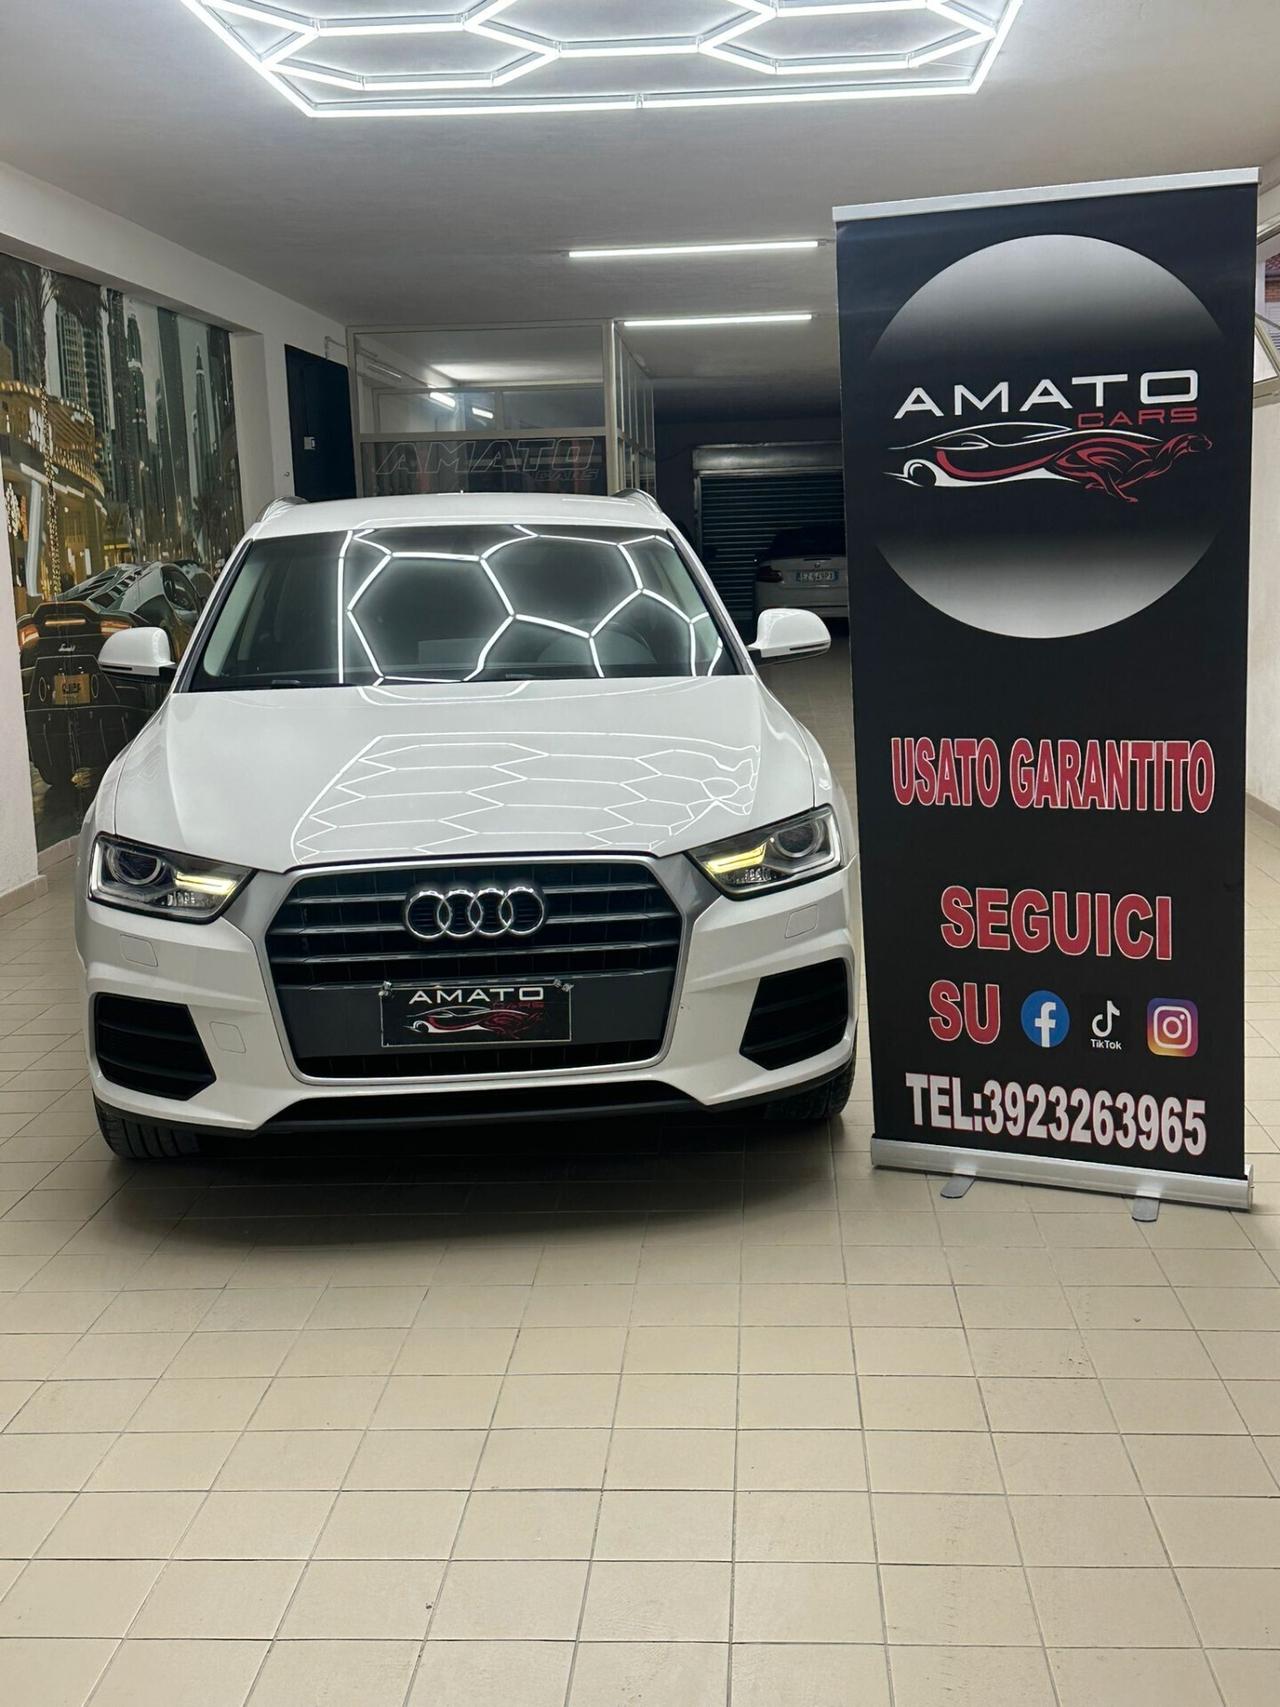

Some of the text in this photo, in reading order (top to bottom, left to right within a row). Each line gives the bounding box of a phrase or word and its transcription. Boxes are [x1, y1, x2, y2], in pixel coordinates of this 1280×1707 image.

[894, 369, 1199, 420] AMATO
[1077, 407, 1199, 429] CARS
[376, 438, 595, 475] AMATO
[891, 737, 1215, 813] USATO GARANTITO
[940, 886, 1172, 960] SEGUICI
[409, 987, 544, 1004] AMATO
[929, 980, 1000, 1044] SU
[1090, 1038, 1122, 1050] TikTok
[905, 1072, 1207, 1156] TEL:3923263965
